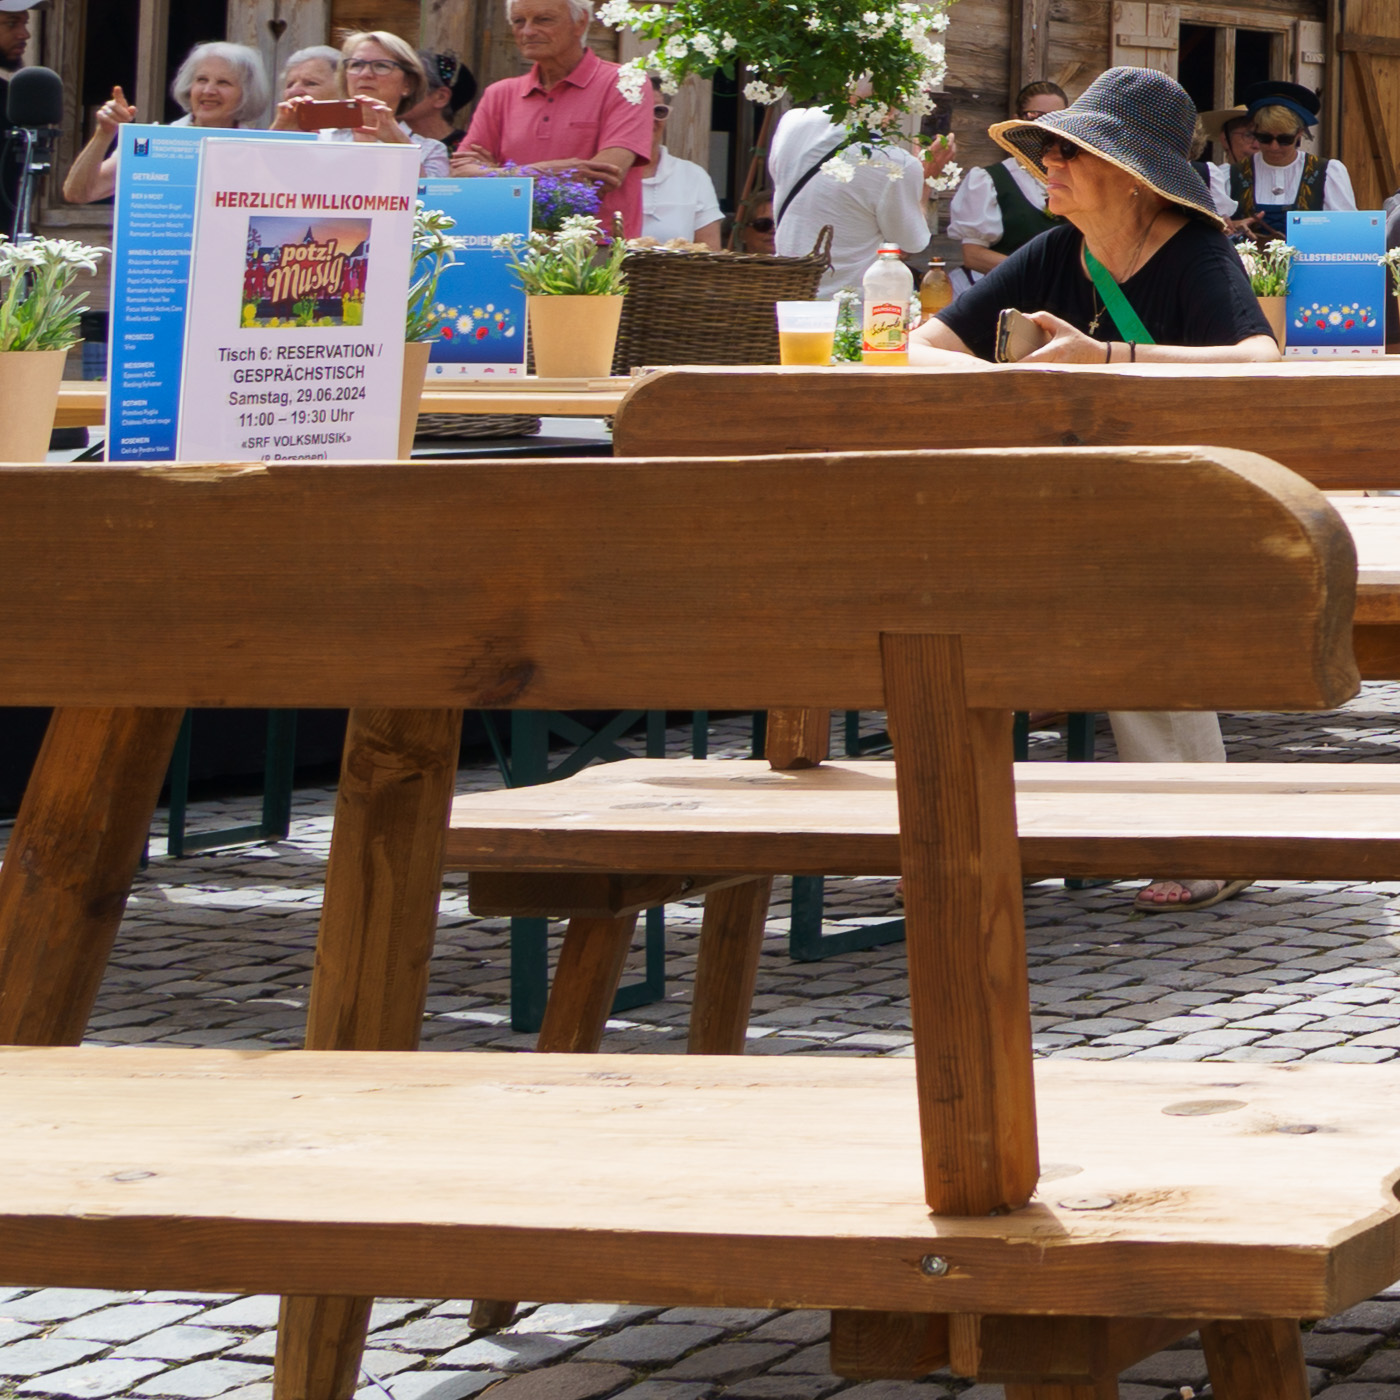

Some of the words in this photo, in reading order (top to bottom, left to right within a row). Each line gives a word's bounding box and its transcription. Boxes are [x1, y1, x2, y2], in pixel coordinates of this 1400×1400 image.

[132, 173, 170, 181] GETRÄNKE
[215, 191, 297, 209] HERZLICH
[301, 193, 409, 211] WILLKOMMEN
[281, 240, 337, 266] potz!
[1293, 253, 1379, 262] SELBSTBEDIENUNG
[267, 254, 344, 303] Musig
[218, 347, 255, 361] Tisch
[259, 347, 272, 360] 6:
[277, 344, 374, 360] RESERVATION
[233, 365, 365, 384] GESPRÄCHSTISCH
[229, 391, 293, 406] Samstag,
[297, 386, 366, 403] 29.06.2024
[239, 412, 275, 427] 11:00
[291, 410, 327, 424] 19:30
[330, 409, 355, 423] Uhr
[241, 436, 271, 449] «SRF
[273, 432, 352, 447] VOLKSMUSIK»
